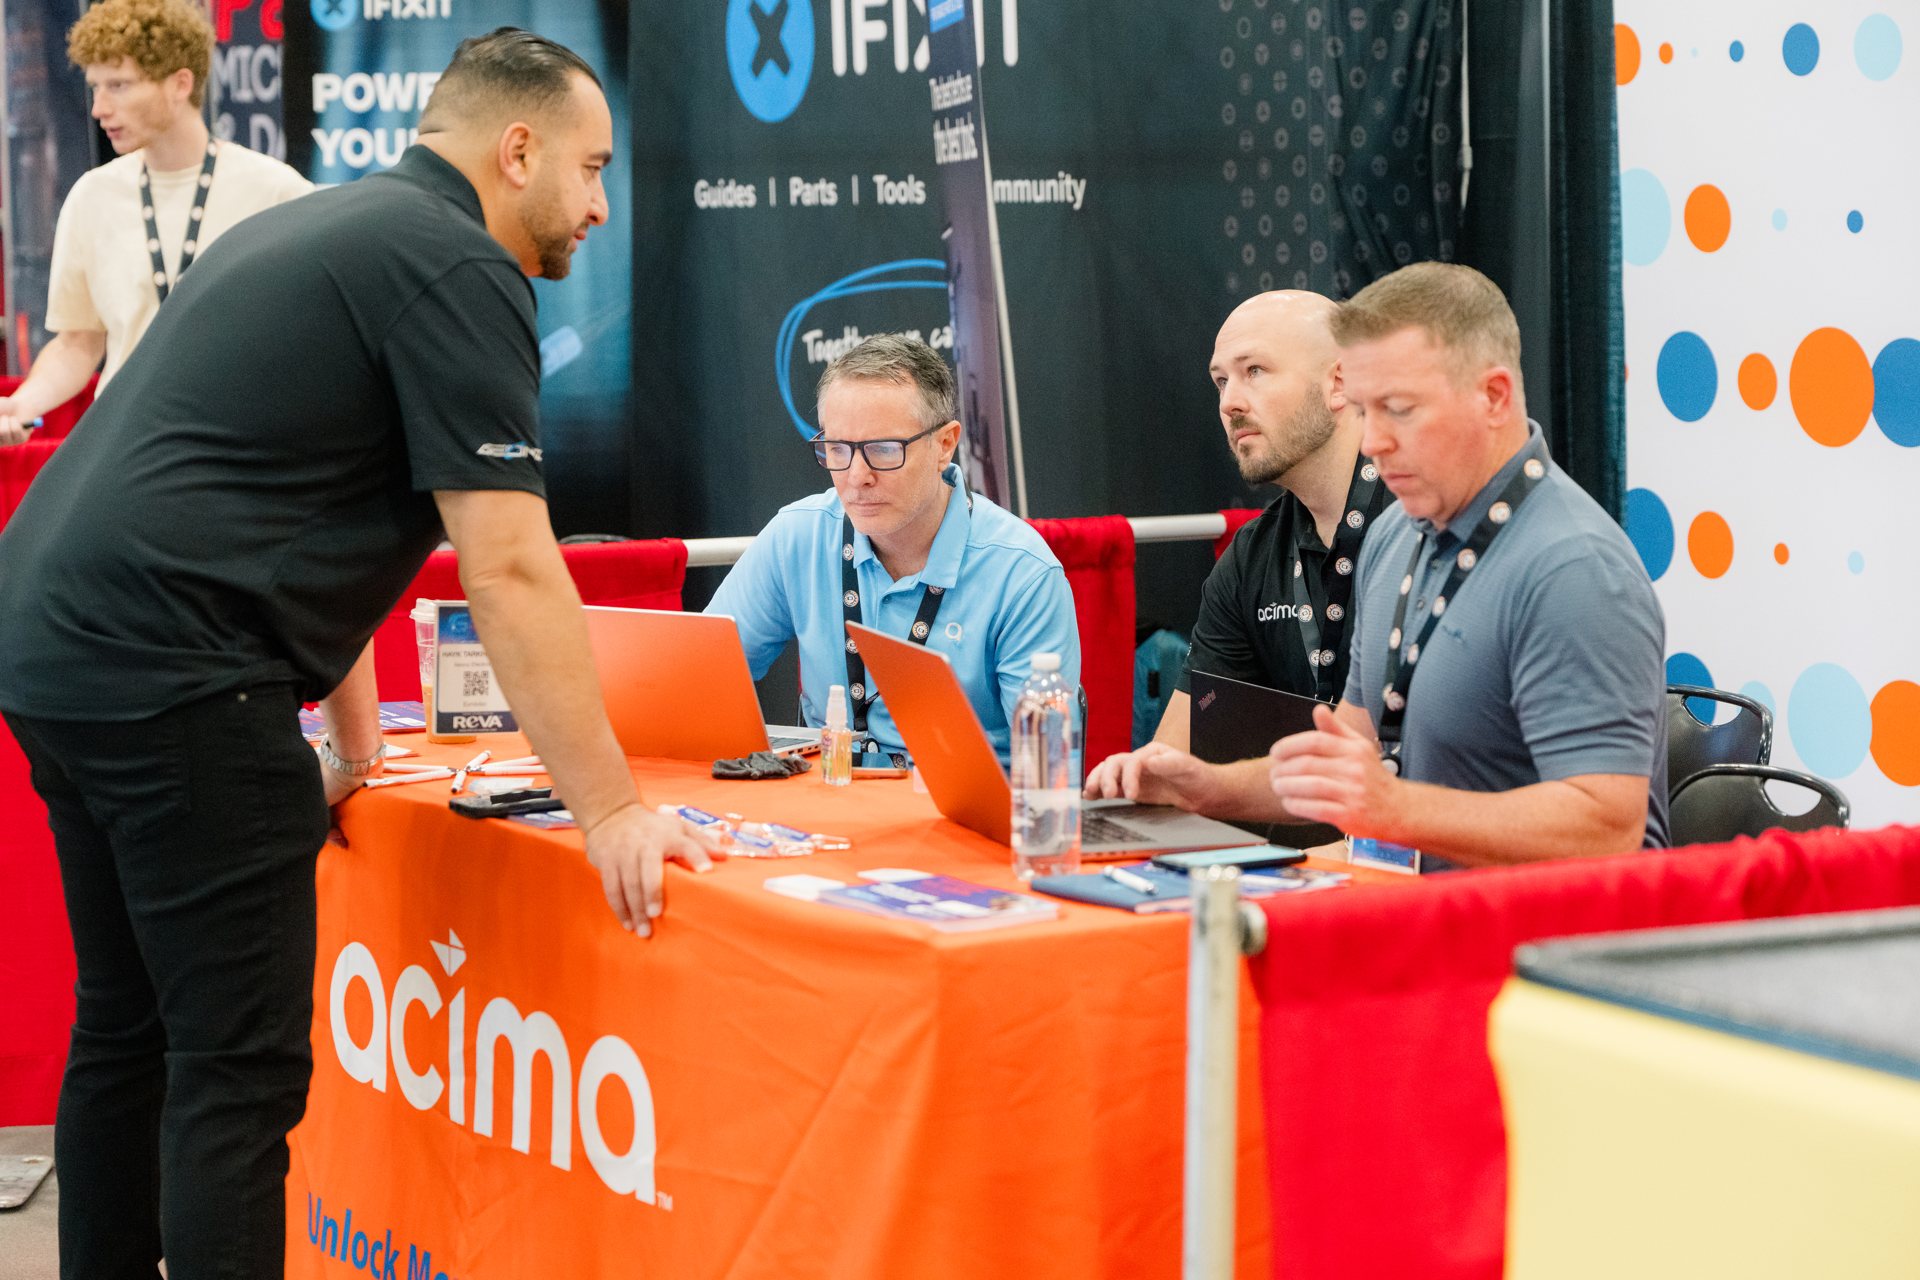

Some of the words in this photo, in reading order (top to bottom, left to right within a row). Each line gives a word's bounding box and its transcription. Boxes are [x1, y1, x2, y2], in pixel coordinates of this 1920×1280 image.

[212, 44, 284, 102] MIC
[312, 72, 443, 113] POWE
[310, 128, 418, 169] YOU
[694, 178, 757, 209] Guides
[789, 176, 839, 207] Parts
[872, 174, 927, 205] Tools
[993, 170, 1087, 210] mmunity
[329, 928, 657, 1206] acima
[307, 1191, 400, 1280] Unlock
